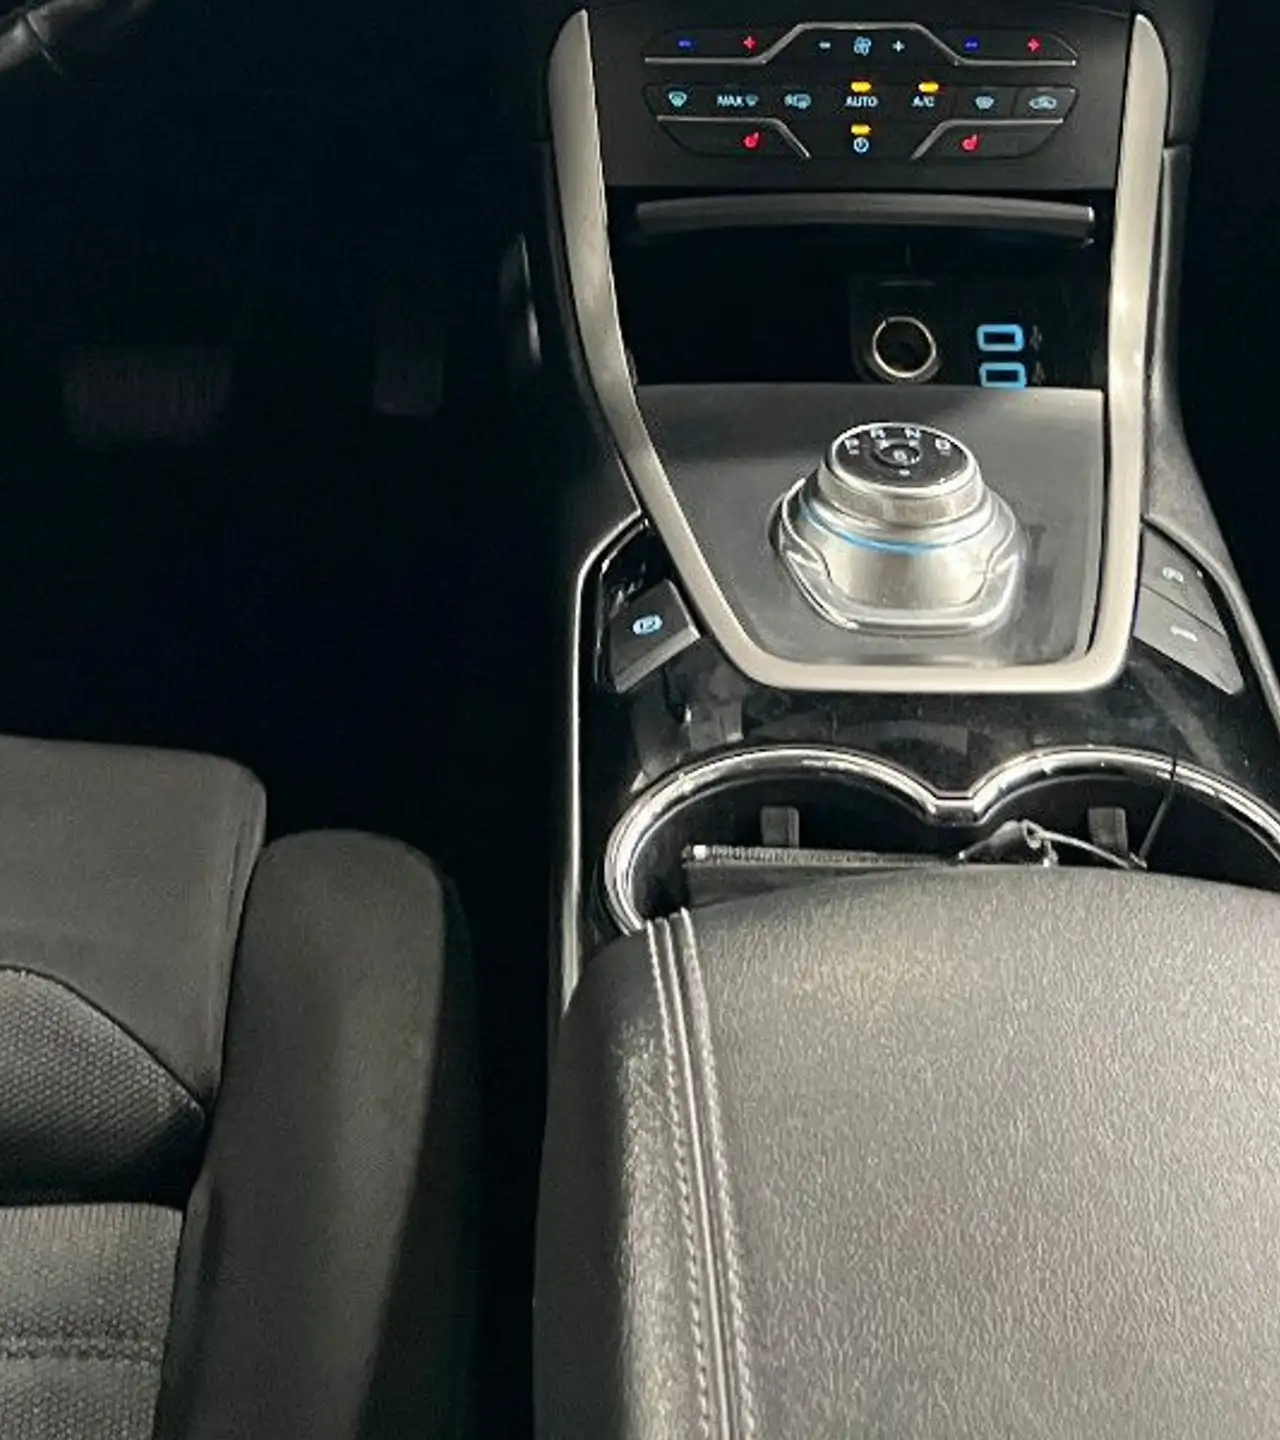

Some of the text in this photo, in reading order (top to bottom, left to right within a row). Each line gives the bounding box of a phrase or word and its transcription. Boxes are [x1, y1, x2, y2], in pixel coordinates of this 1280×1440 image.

[717, 94, 745, 106] MAX
[845, 95, 879, 108] AUTO
[912, 96, 936, 107] A/C
